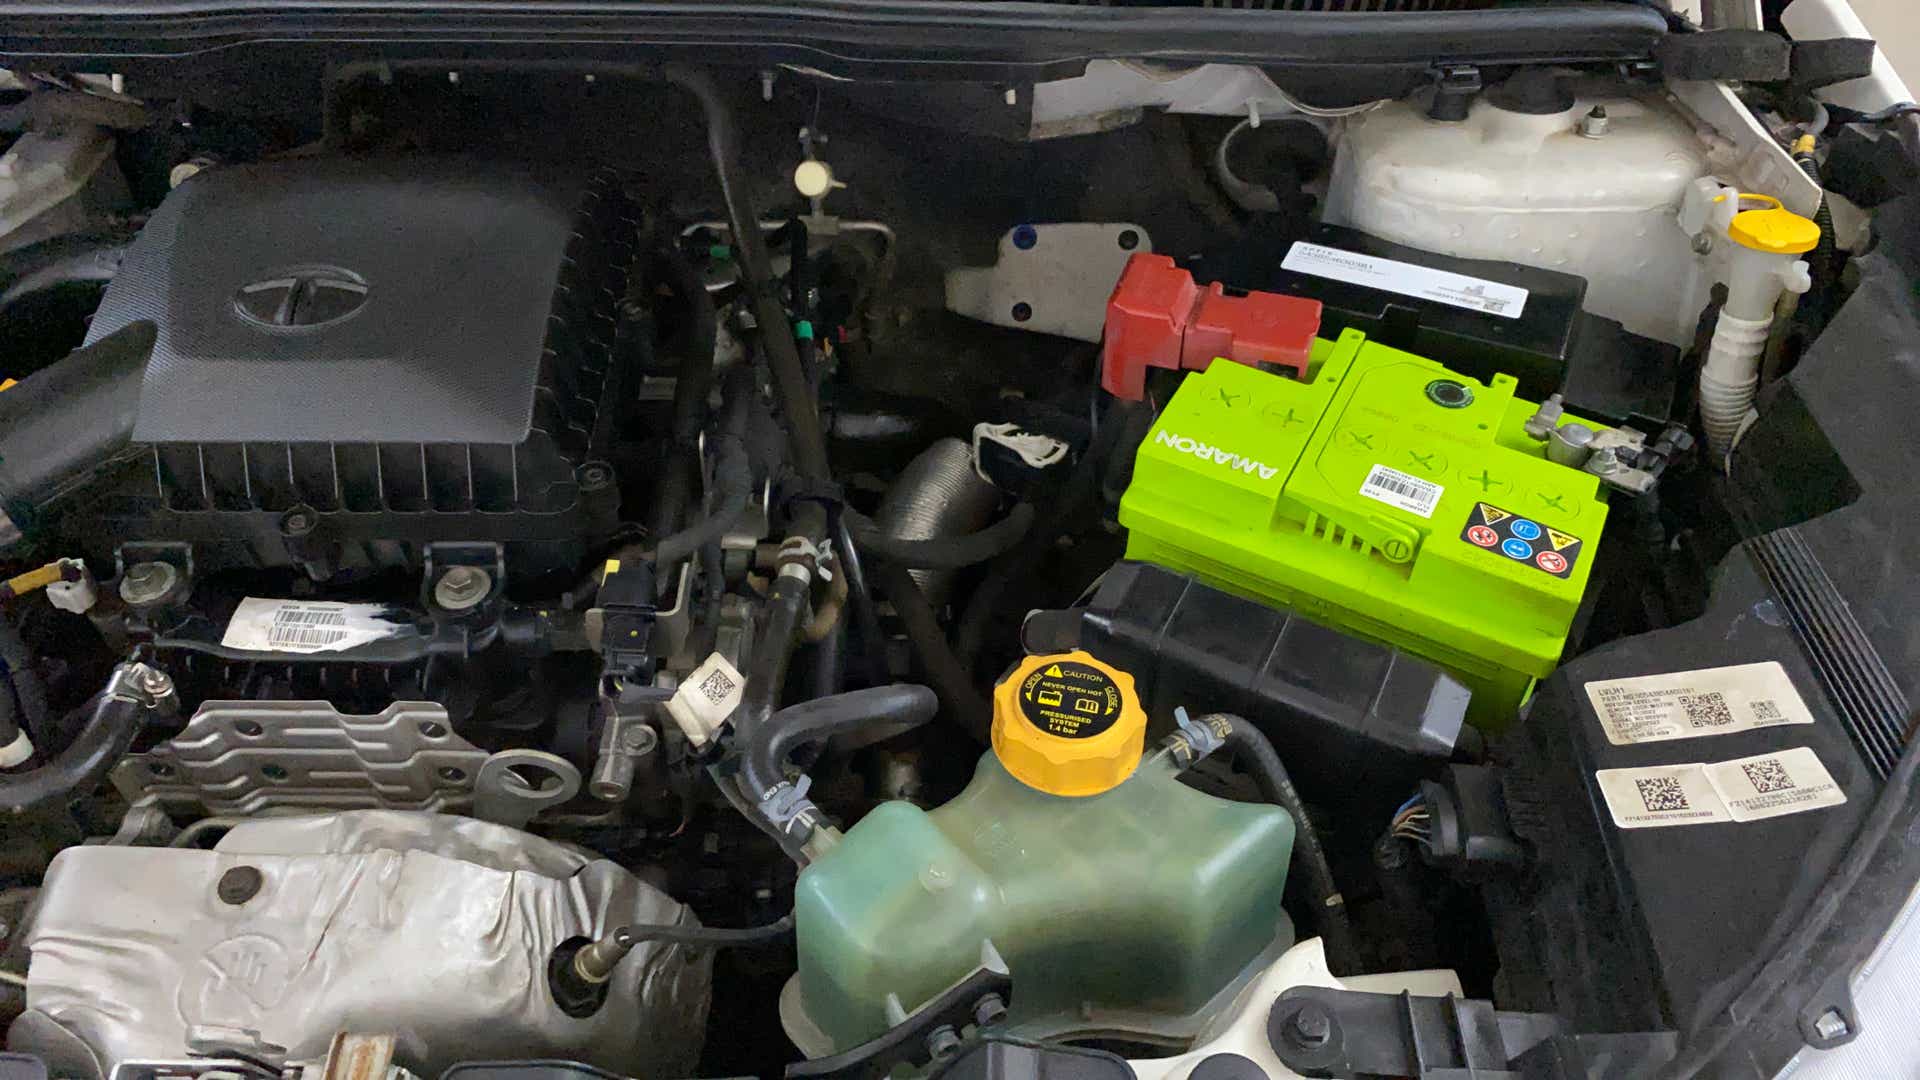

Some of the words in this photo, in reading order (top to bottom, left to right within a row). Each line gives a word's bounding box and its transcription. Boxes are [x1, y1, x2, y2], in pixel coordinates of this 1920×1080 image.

[1155, 429, 1279, 480] AMARON
[1025, 672, 1043, 689] OPEN
[1063, 670, 1103, 682] CAUTION
[1042, 681, 1066, 691] NEVER
[1066, 685, 1087, 694] OPEN
[1087, 689, 1102, 697] HOT
[1106, 685, 1118, 708] CLOSE
[1040, 709, 1092, 723] PRESSURISED
[1049, 718, 1080, 728] SYSTEM
[1049, 723, 1061, 732] 1.4
